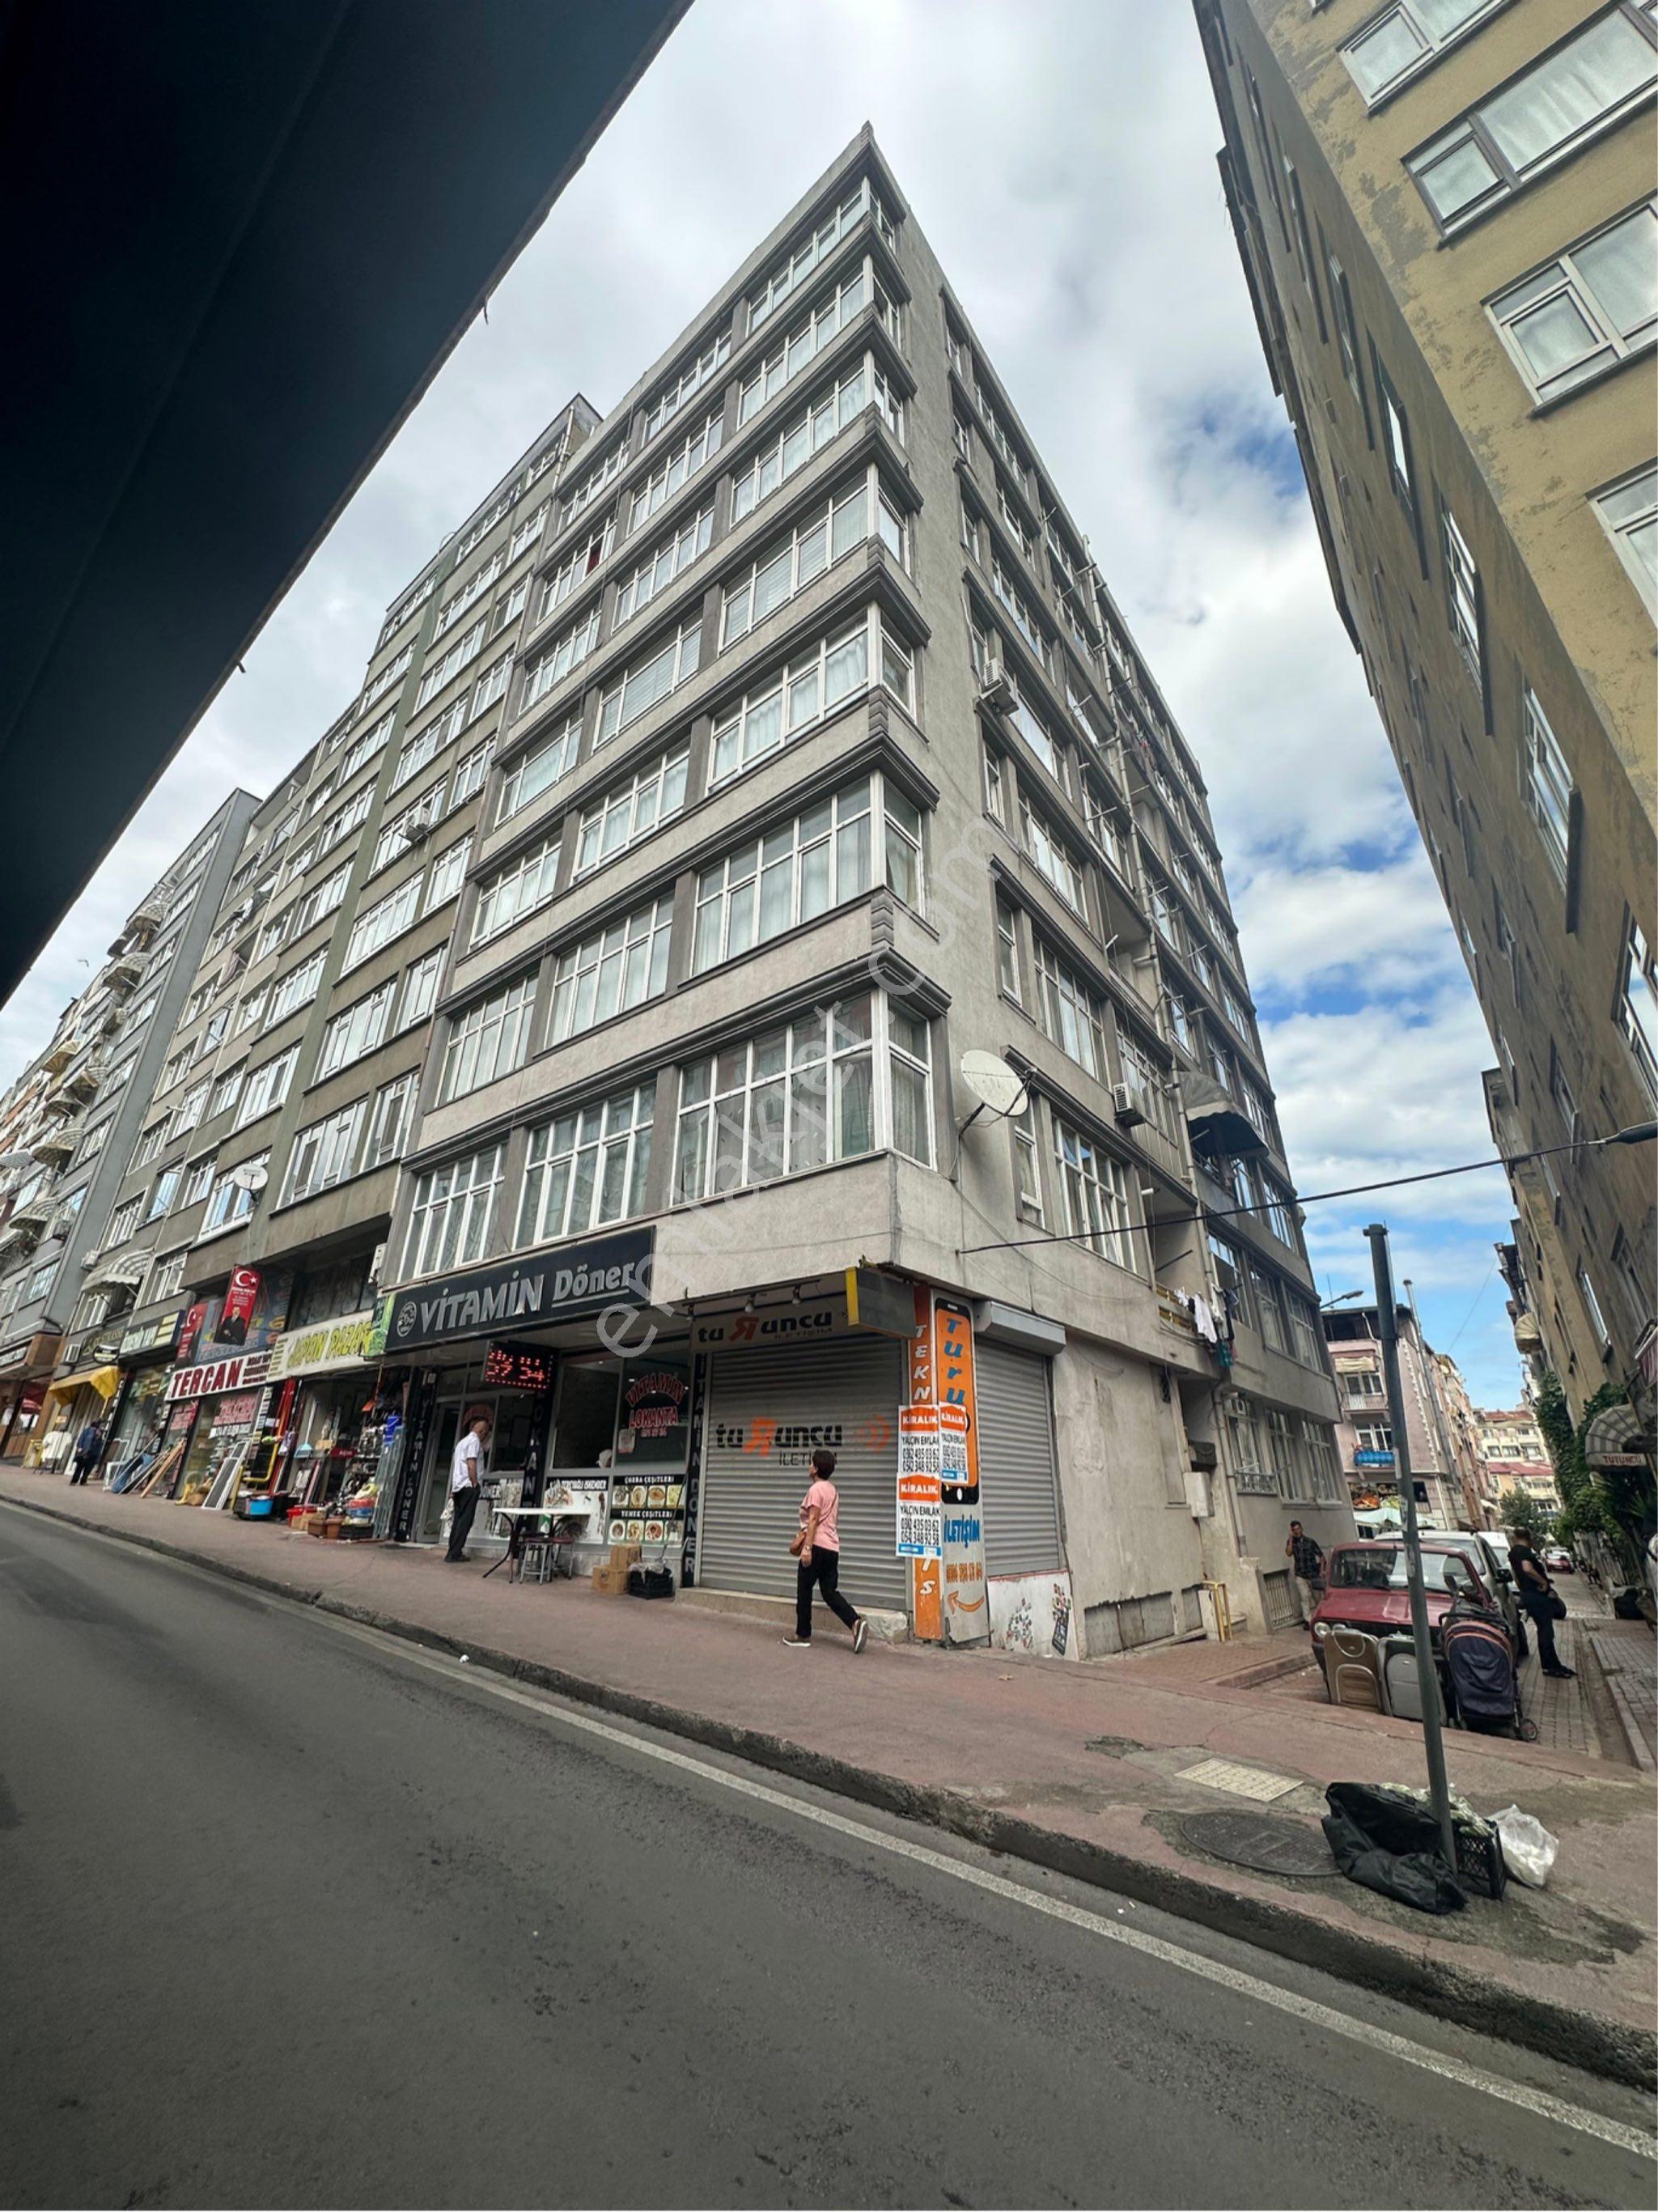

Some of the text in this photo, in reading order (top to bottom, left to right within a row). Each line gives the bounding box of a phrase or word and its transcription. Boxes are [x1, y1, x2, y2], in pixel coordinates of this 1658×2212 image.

[420, 1270, 545, 1333] VİTAMİN
[553, 1261, 635, 1301] Döner
[171, 1359, 244, 1398] TERCAN
[629, 1406, 679, 1429] LOKANTA
[901, 1482, 939, 1494] KİRALIK
